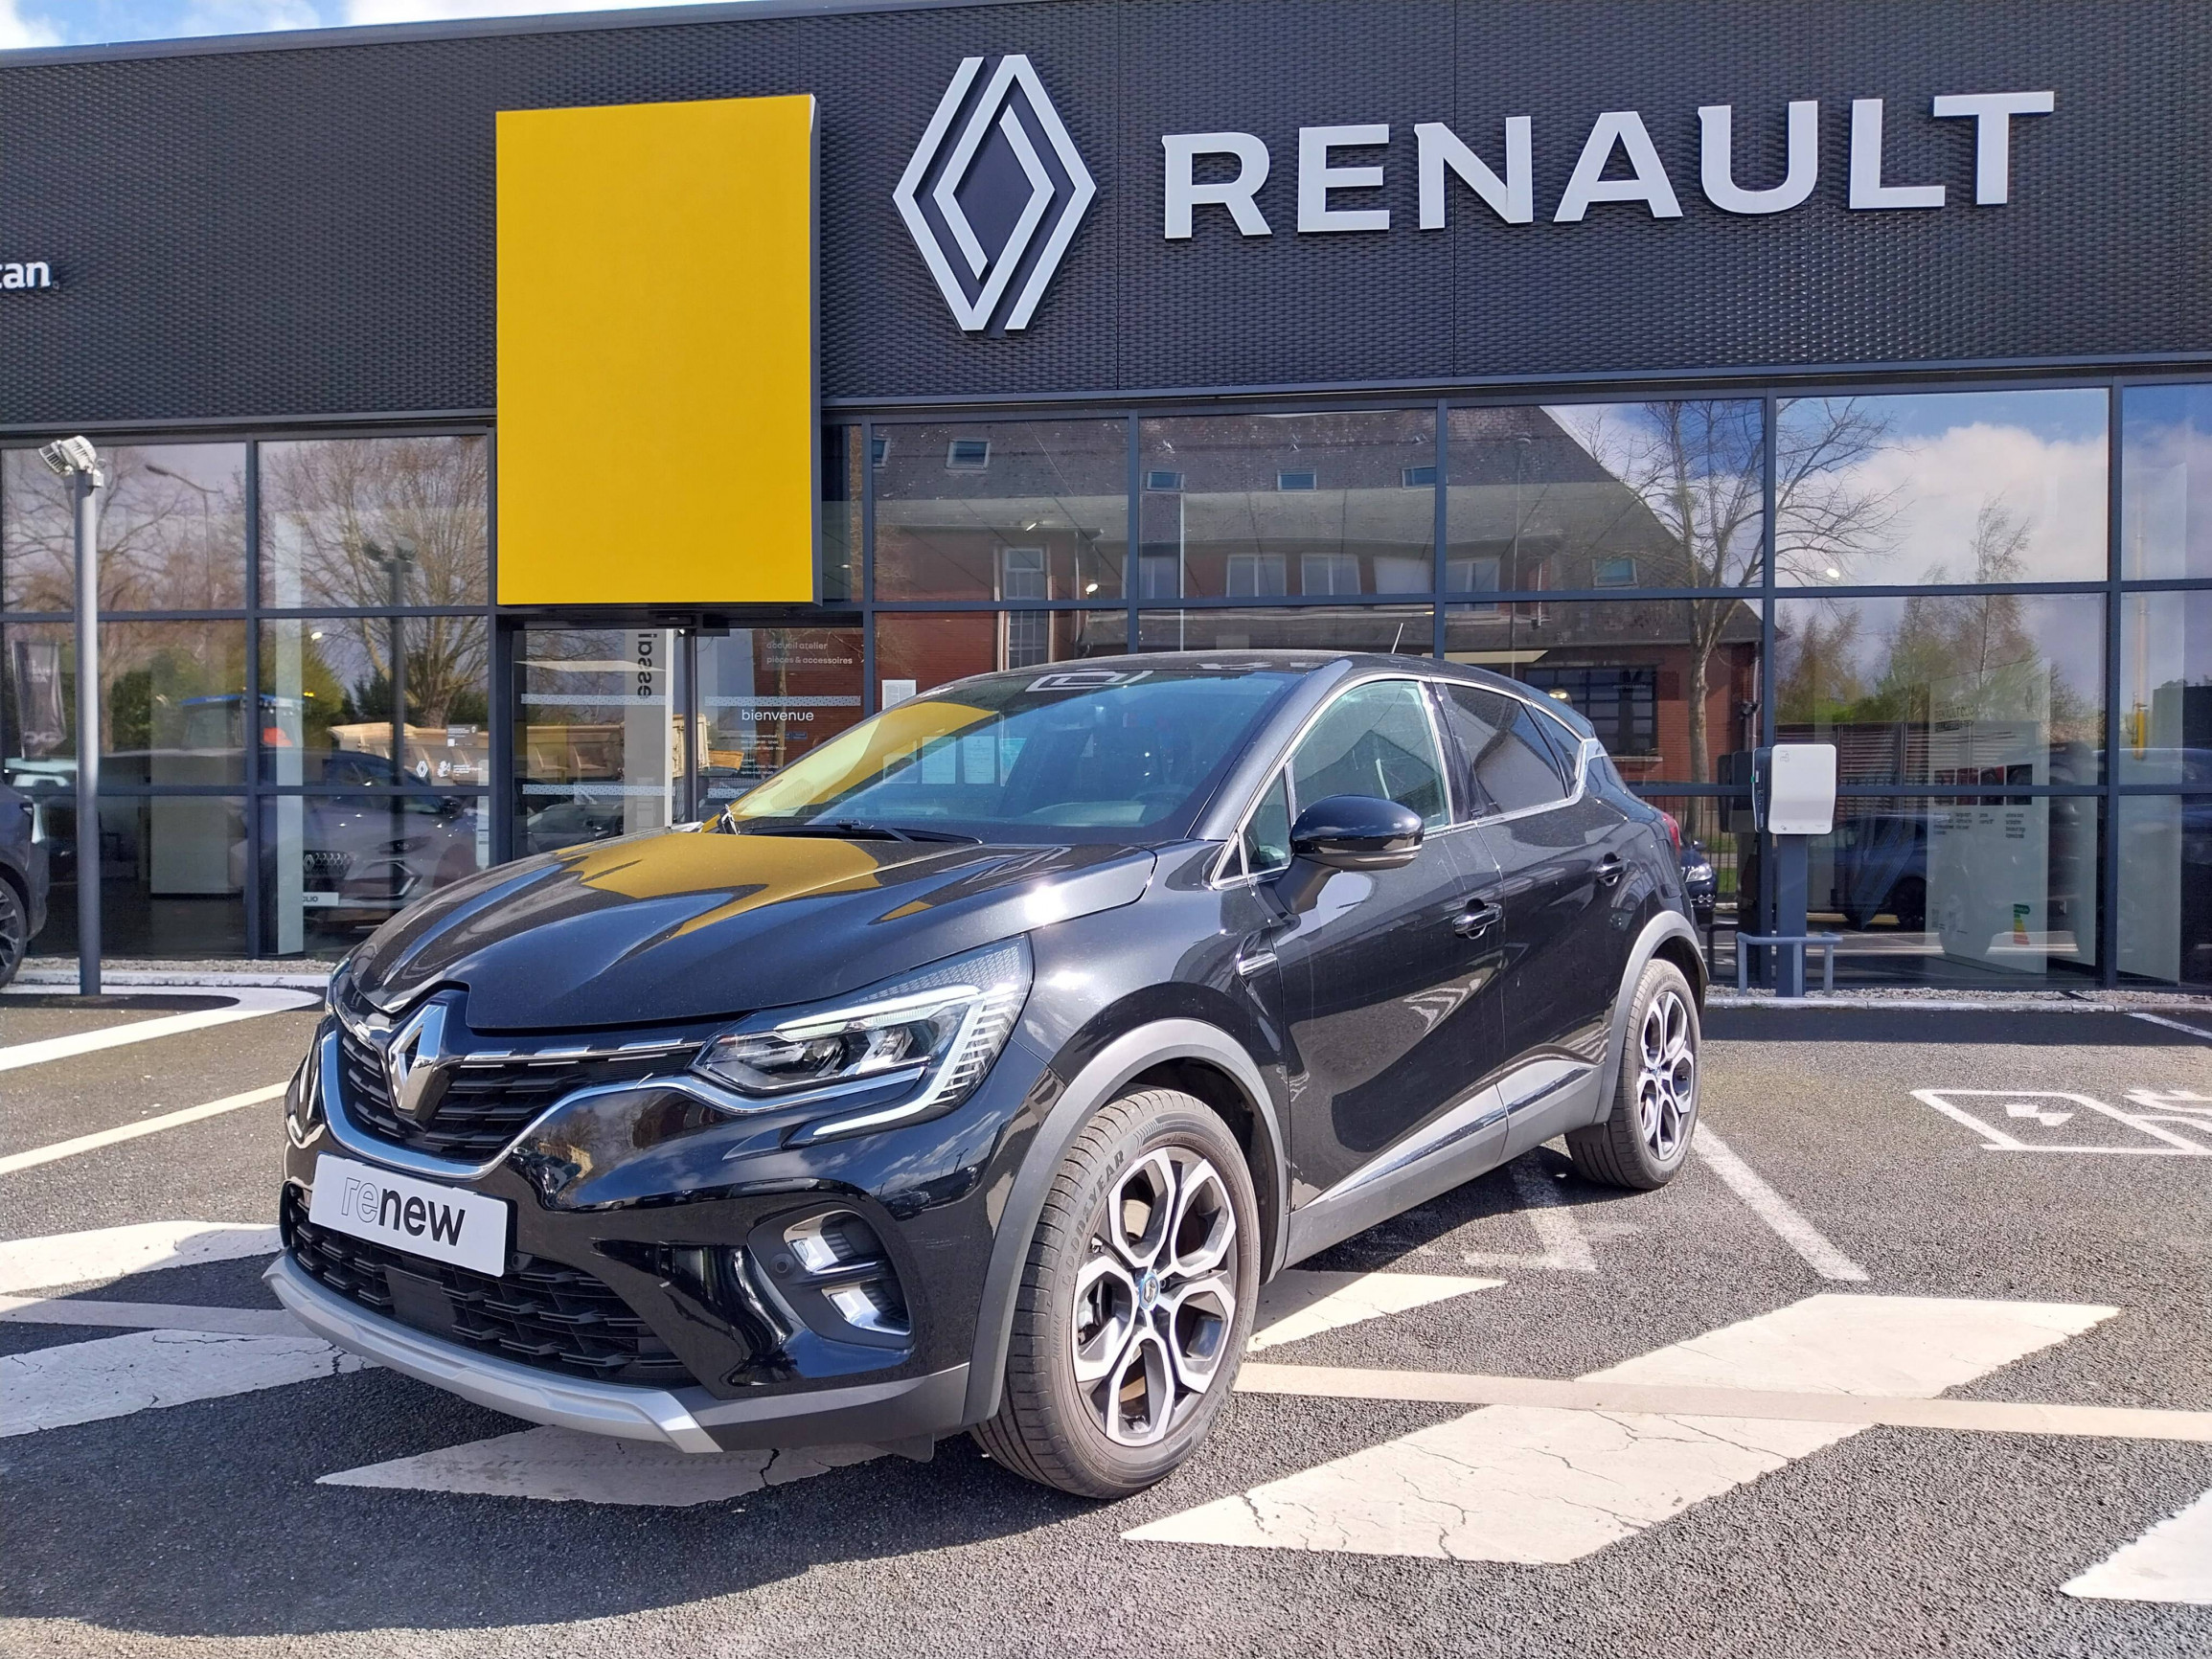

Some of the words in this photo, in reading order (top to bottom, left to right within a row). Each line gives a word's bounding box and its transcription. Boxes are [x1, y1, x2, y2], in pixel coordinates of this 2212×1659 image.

[1161, 91, 2055, 239] RENAULT
[766, 641, 797, 649] accueil
[799, 641, 828, 649] atelier
[766, 656, 794, 666] pièces
[795, 656, 802, 665] &
[803, 656, 853, 665] accessoires
[741, 709, 814, 721] bienvenue
[341, 1176, 466, 1247] renew
